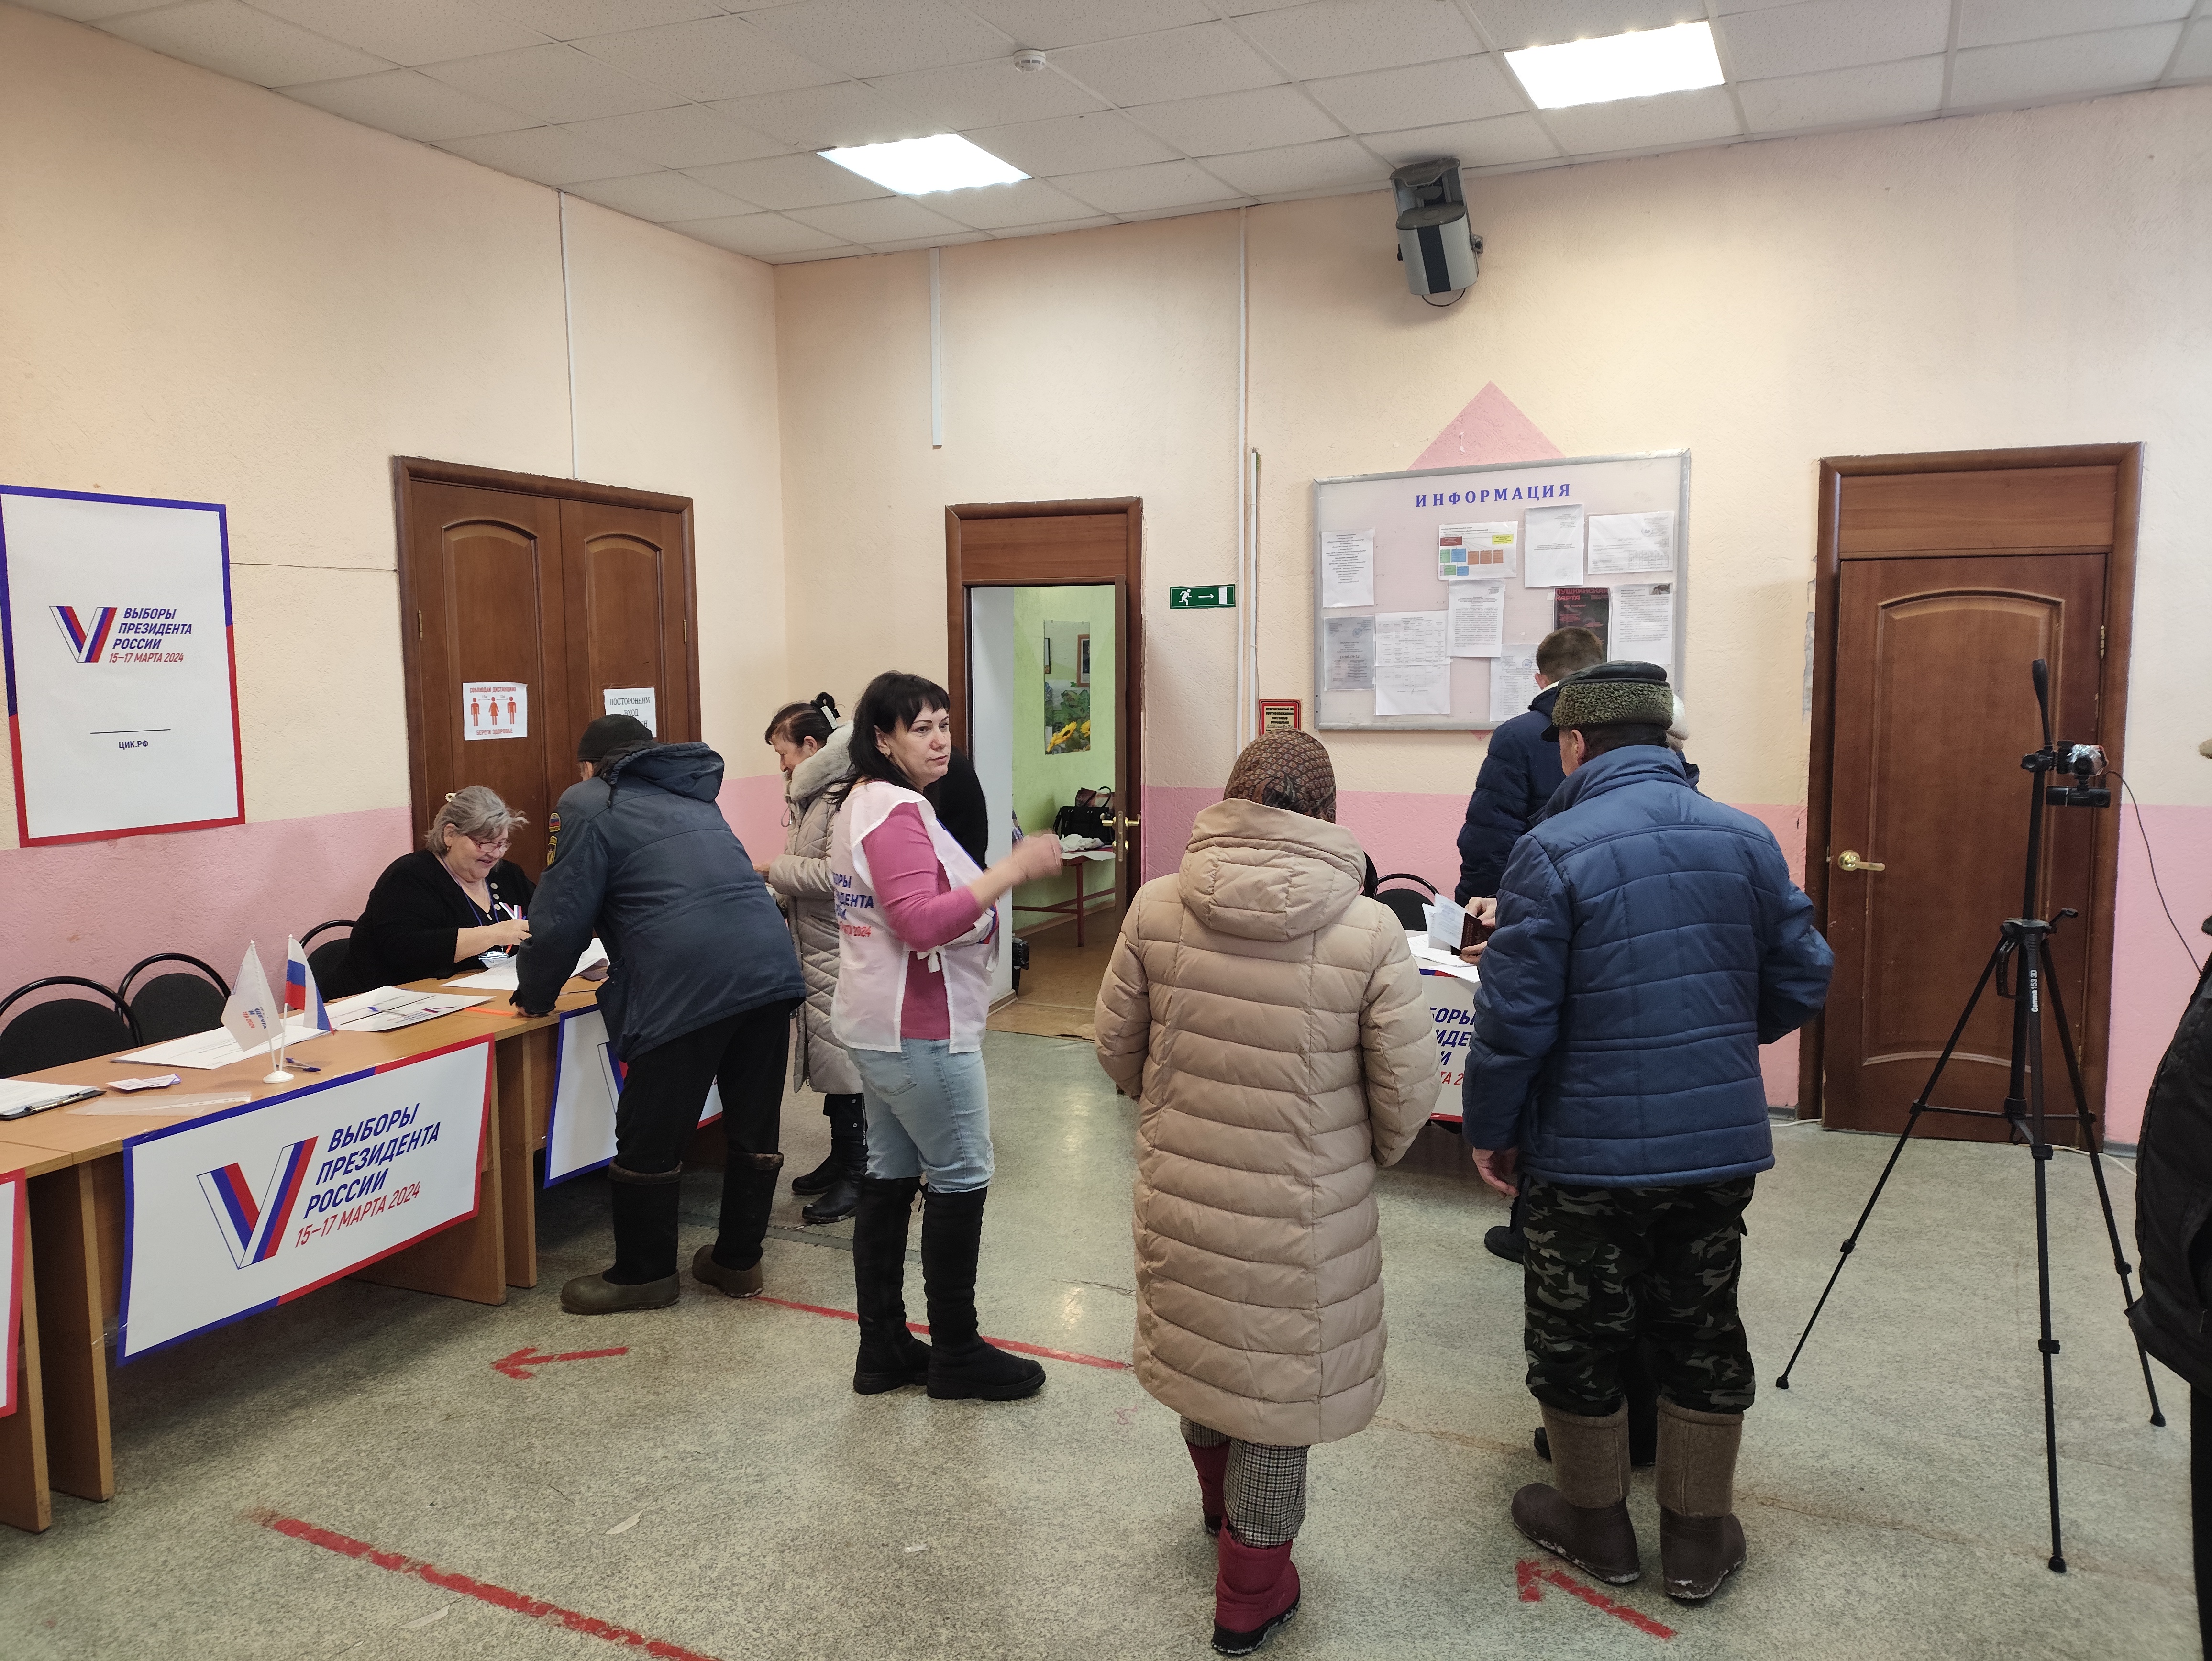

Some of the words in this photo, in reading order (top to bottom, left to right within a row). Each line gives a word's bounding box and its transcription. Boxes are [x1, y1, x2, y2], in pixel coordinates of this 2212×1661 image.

[1416, 484, 1570, 507] ИНФОРМАЦИЯ
[123, 608, 177, 619] ВЫБОРЫ
[118, 623, 192, 636] ПРЕЗИДЕНТА
[112, 638, 162, 649] РОССИИ
[133, 653, 162, 663] МАРТА
[164, 653, 184, 663] 2024
[609, 697, 650, 705] ПОСТОРОННИМ
[119, 740, 148, 750] ЦИК.РФ
[327, 1103, 420, 1152] ВЫБОРЫ
[315, 1122, 441, 1185] ПРЕЗИДЕНТА
[303, 1168, 389, 1219] РОССИИ
[337, 1195, 387, 1230] МАРТА
[388, 1181, 420, 1210] 2024
